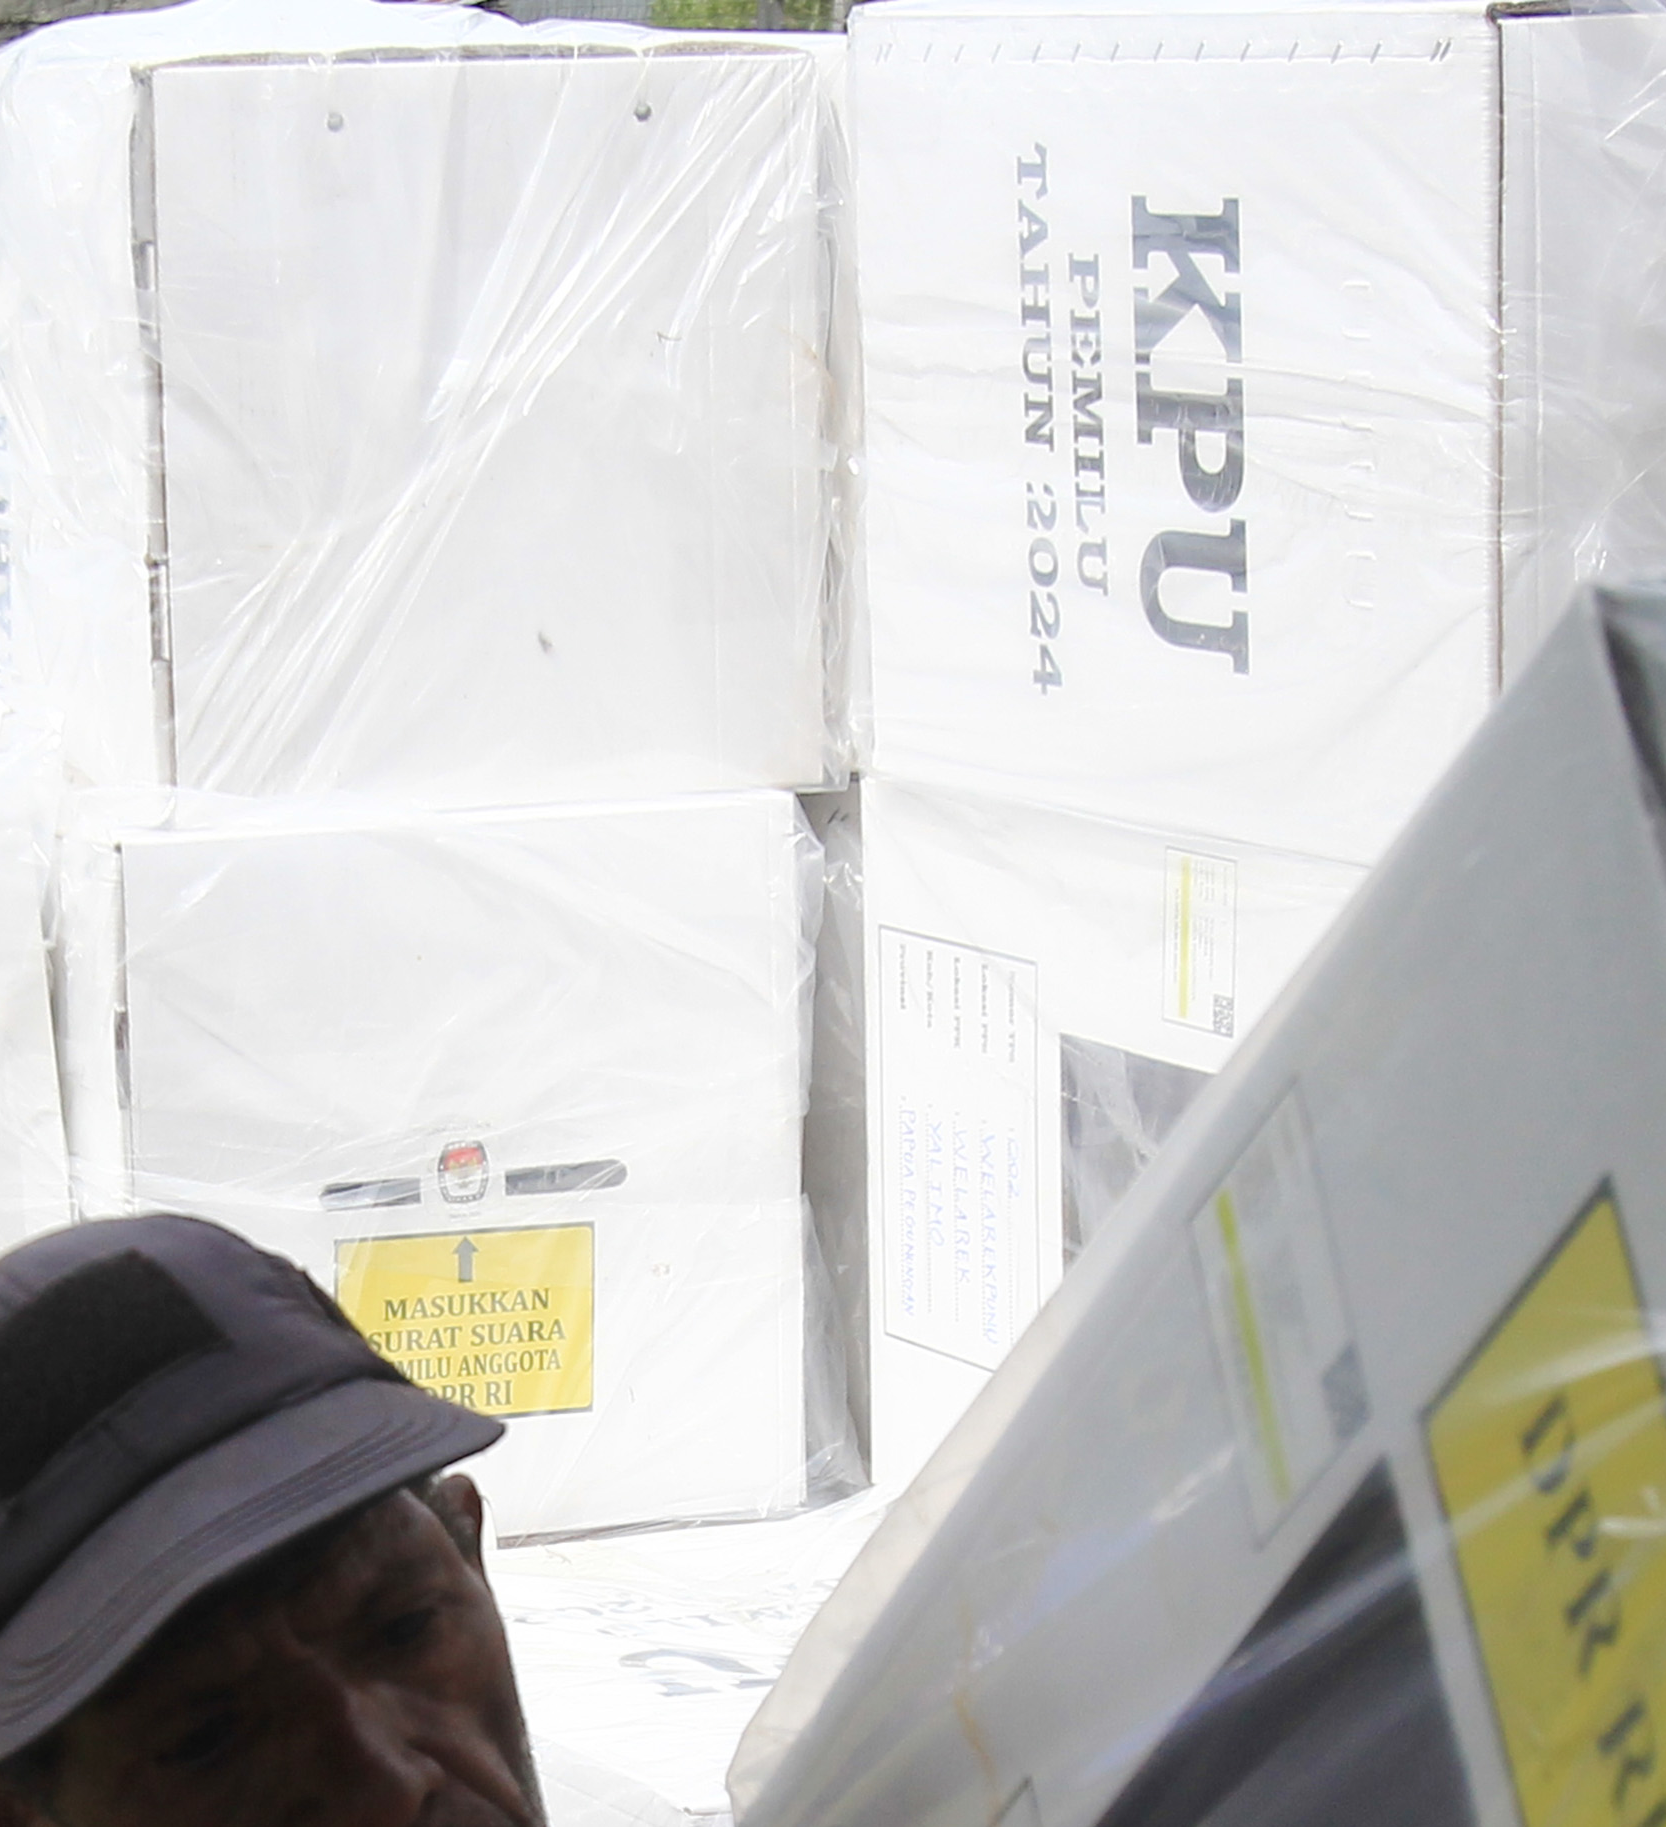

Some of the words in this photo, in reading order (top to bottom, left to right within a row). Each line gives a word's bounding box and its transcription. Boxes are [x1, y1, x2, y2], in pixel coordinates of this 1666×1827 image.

[1016, 142, 1055, 452] TAHUN
[1068, 252, 1109, 597] PEMILU
[1132, 195, 1250, 675] KPU
[1026, 481, 1063, 695] 2024
[368, 1324, 463, 1354] SURAT
[470, 1317, 567, 1348] SUARA
[383, 1287, 551, 1323] MASUKKAN
[395, 1354, 452, 1381] MILU
[457, 1349, 562, 1378] ANGGOTA
[485, 1380, 514, 1407] RI
[1521, 1394, 1623, 1678] DPR
